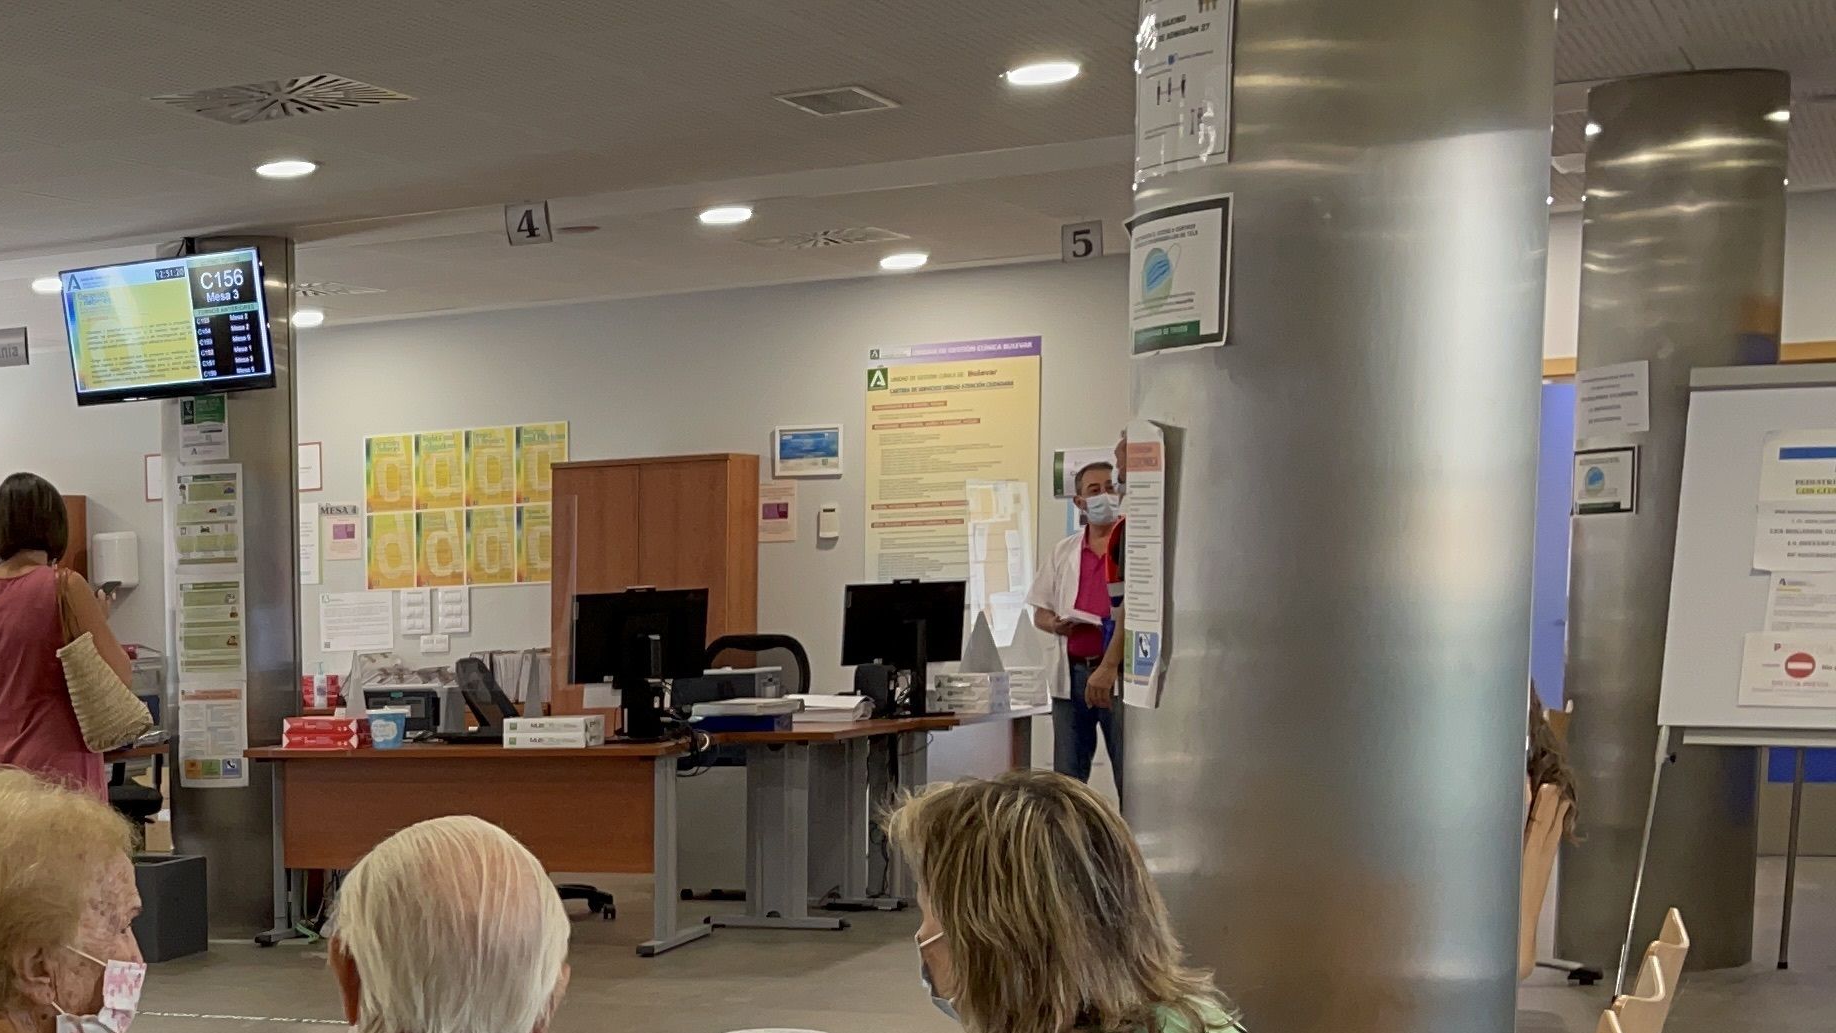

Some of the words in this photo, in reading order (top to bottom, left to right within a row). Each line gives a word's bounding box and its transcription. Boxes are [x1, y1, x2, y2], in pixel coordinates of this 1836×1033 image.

[516, 208, 540, 239] 4
[1071, 228, 1093, 258] 5
[200, 268, 245, 290] C156
[206, 291, 231, 303] Mesa
[232, 289, 240, 300] 3
[320, 506, 347, 516] MESA
